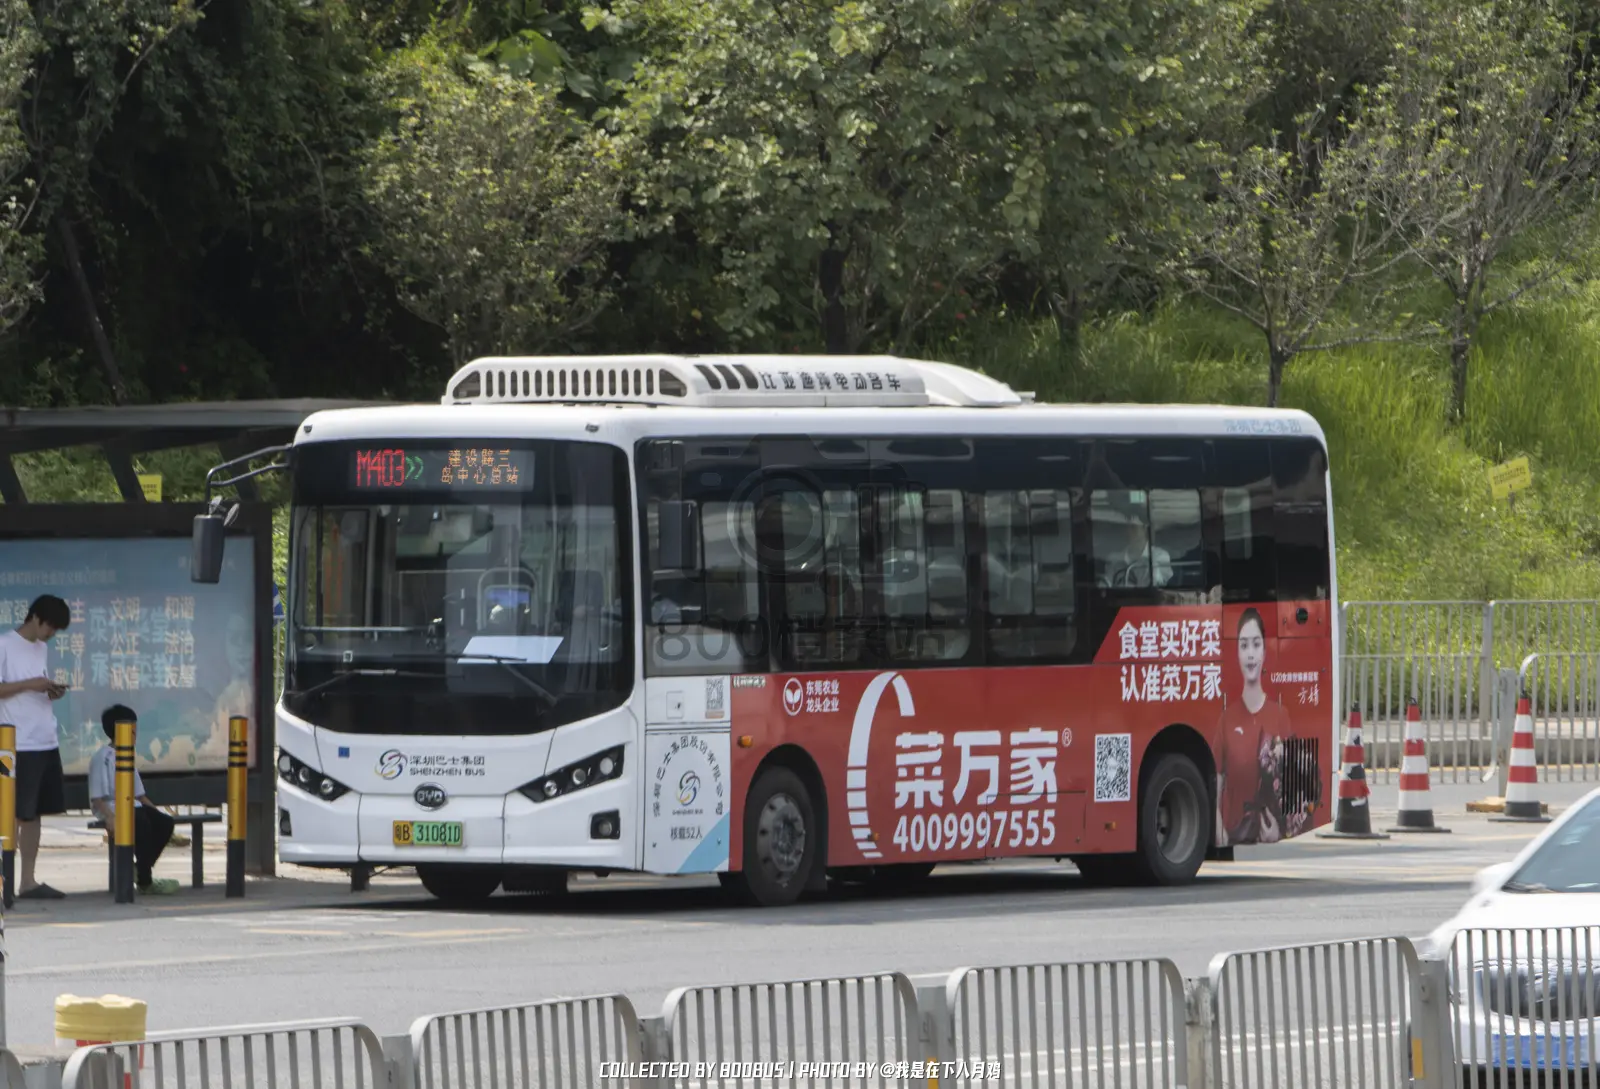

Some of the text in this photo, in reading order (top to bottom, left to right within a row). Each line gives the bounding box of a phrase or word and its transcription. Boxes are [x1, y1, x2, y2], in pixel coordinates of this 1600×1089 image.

[758, 371, 901, 391] 比亚迪纯电动客车
[356, 449, 405, 487] M403
[110, 596, 141, 620] 文明
[54, 630, 195, 659] 平等 公正 法治
[1118, 619, 1221, 660] 食堂买好菜
[806, 679, 840, 695] 东莞农业
[1119, 663, 1222, 702] 认准菜万家
[806, 698, 840, 713] 龙头企业
[409, 755, 486, 766] 深圳巴士集团
[409, 767, 486, 777] SHENZHEN BUS
[894, 727, 1059, 809] 菜万家
[893, 808, 1056, 852] 4009997555
